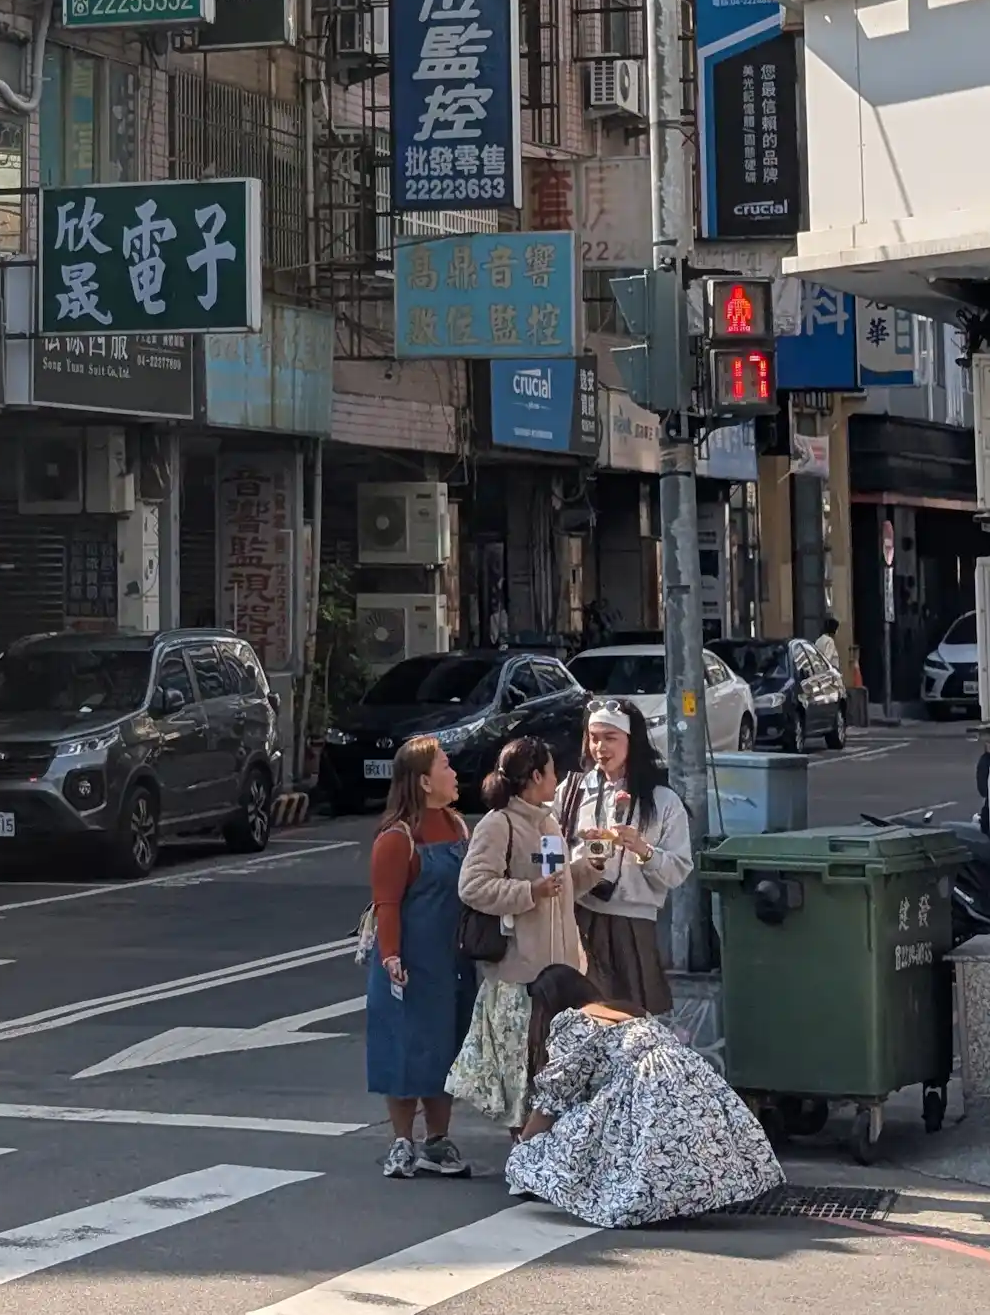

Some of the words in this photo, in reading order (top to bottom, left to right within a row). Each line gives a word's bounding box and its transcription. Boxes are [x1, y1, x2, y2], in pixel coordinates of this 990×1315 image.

[405, 144, 506, 177] 批發零售
[405, 178, 506, 200] 22223633
[734, 199, 789, 216] crucial
[42, 357, 62, 372] Song
[66, 358, 84, 374] Yuan
[513, 368, 552, 400] crucial
